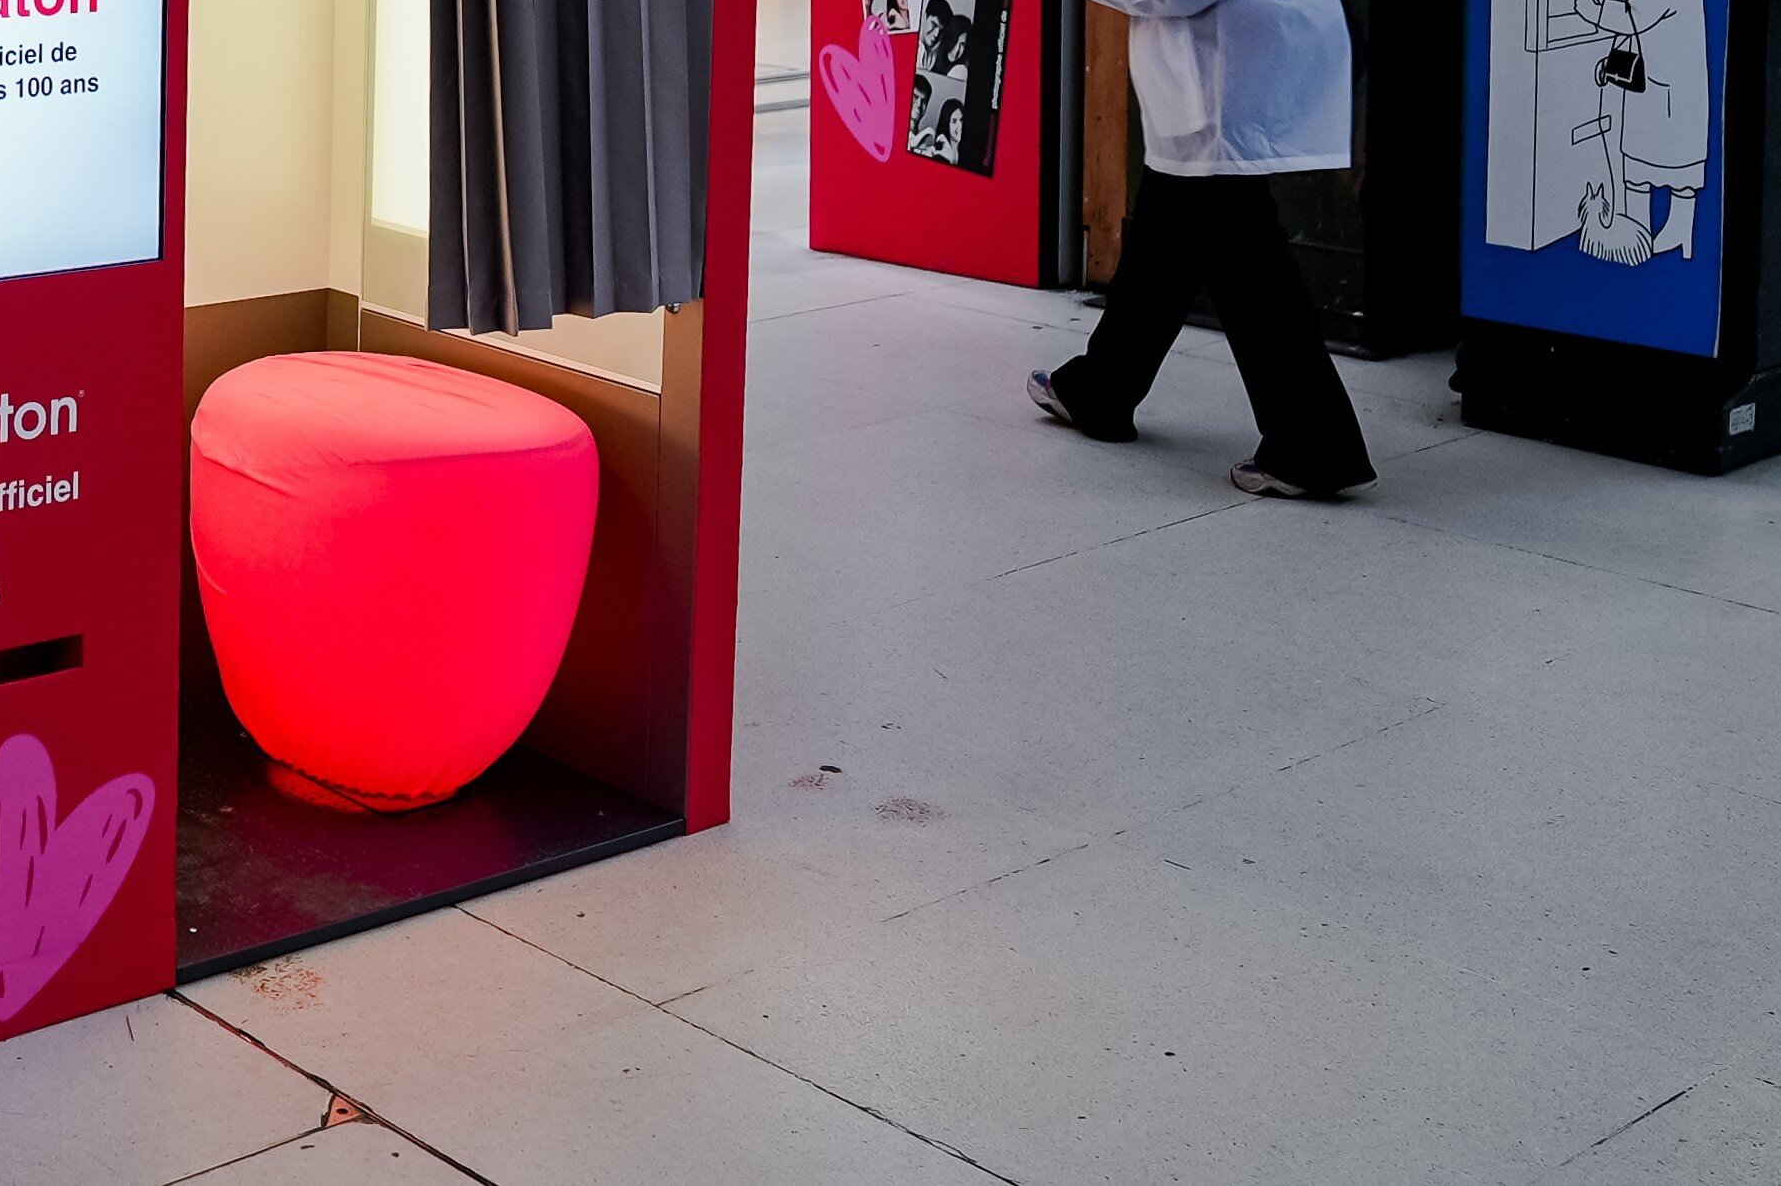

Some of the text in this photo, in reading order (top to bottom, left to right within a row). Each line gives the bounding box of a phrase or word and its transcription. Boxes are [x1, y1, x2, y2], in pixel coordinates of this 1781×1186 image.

[51, 42, 78, 62] de
[15, 76, 53, 98] 100
[60, 75, 100, 95] ans
